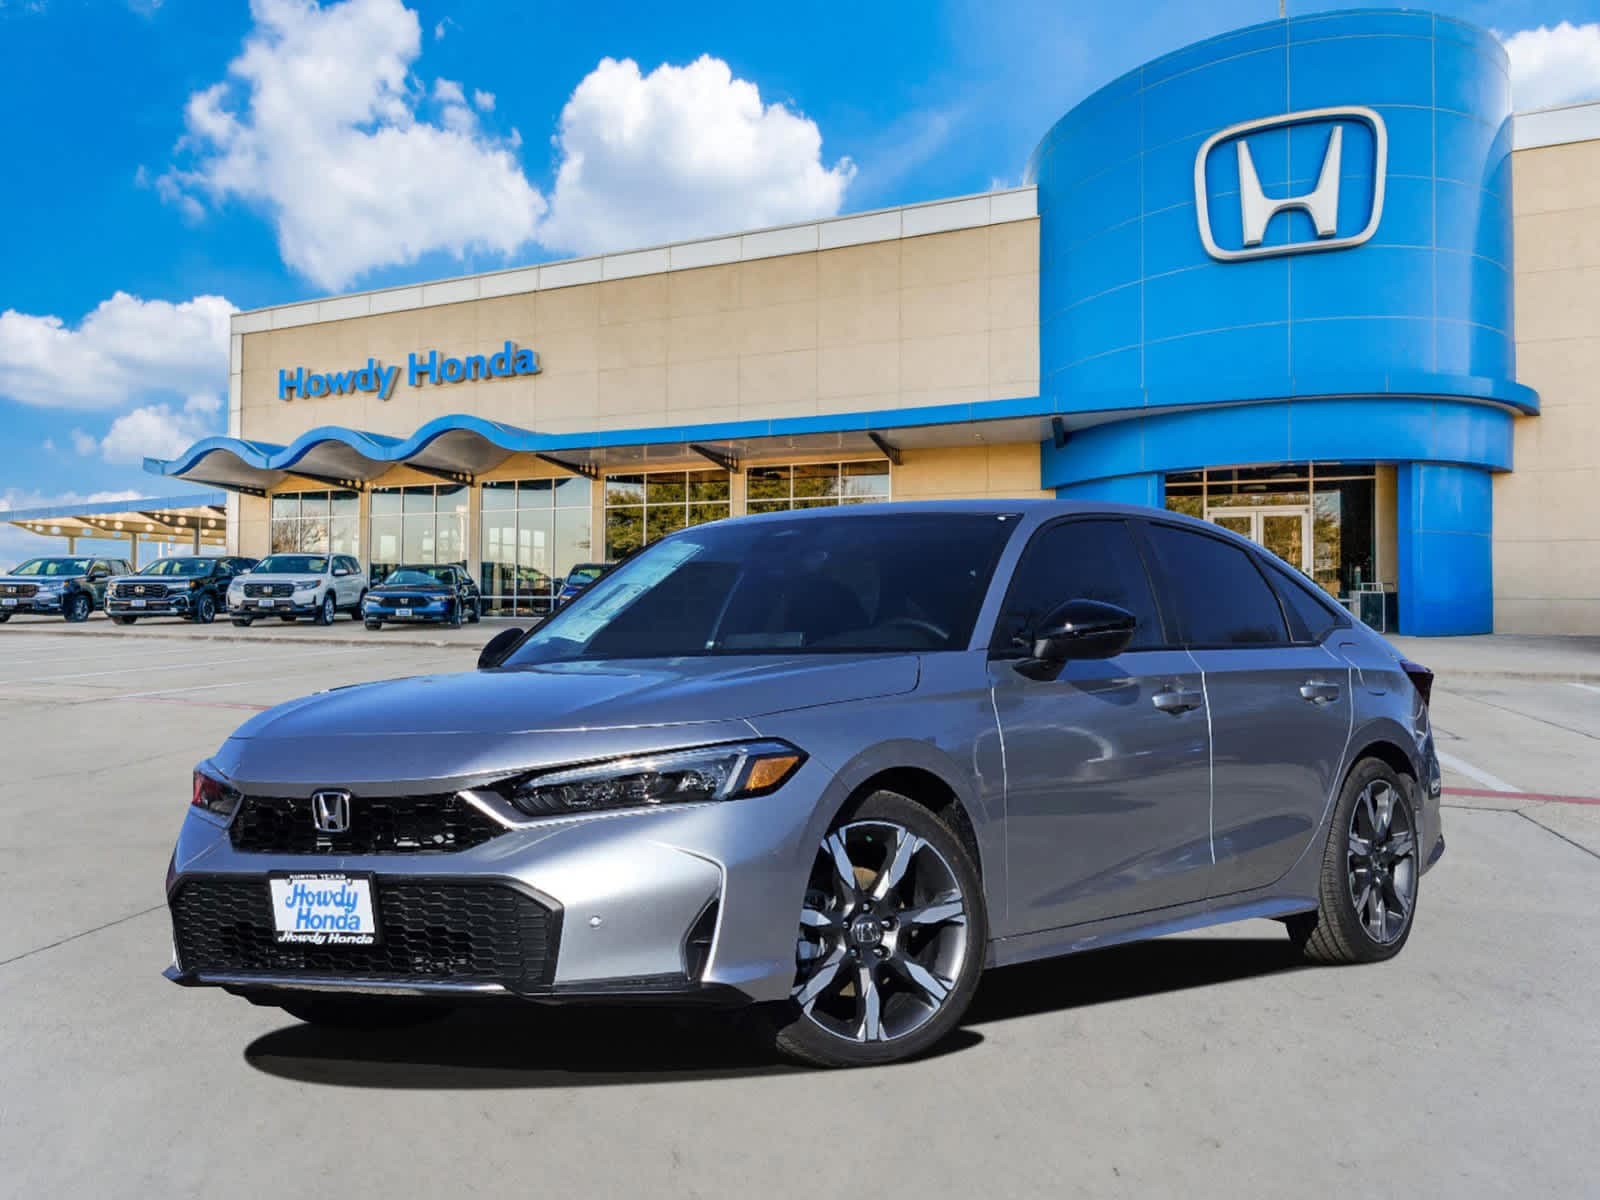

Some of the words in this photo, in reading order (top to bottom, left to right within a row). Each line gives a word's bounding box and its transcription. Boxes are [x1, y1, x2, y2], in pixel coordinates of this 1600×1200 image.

[278, 358, 400, 401] Howdy
[408, 340, 540, 388] Honda
[286, 884, 358, 913] Howdy
[296, 908, 360, 930] Honda
[278, 931, 325, 944] Howdy
[328, 933, 374, 944] Honda
